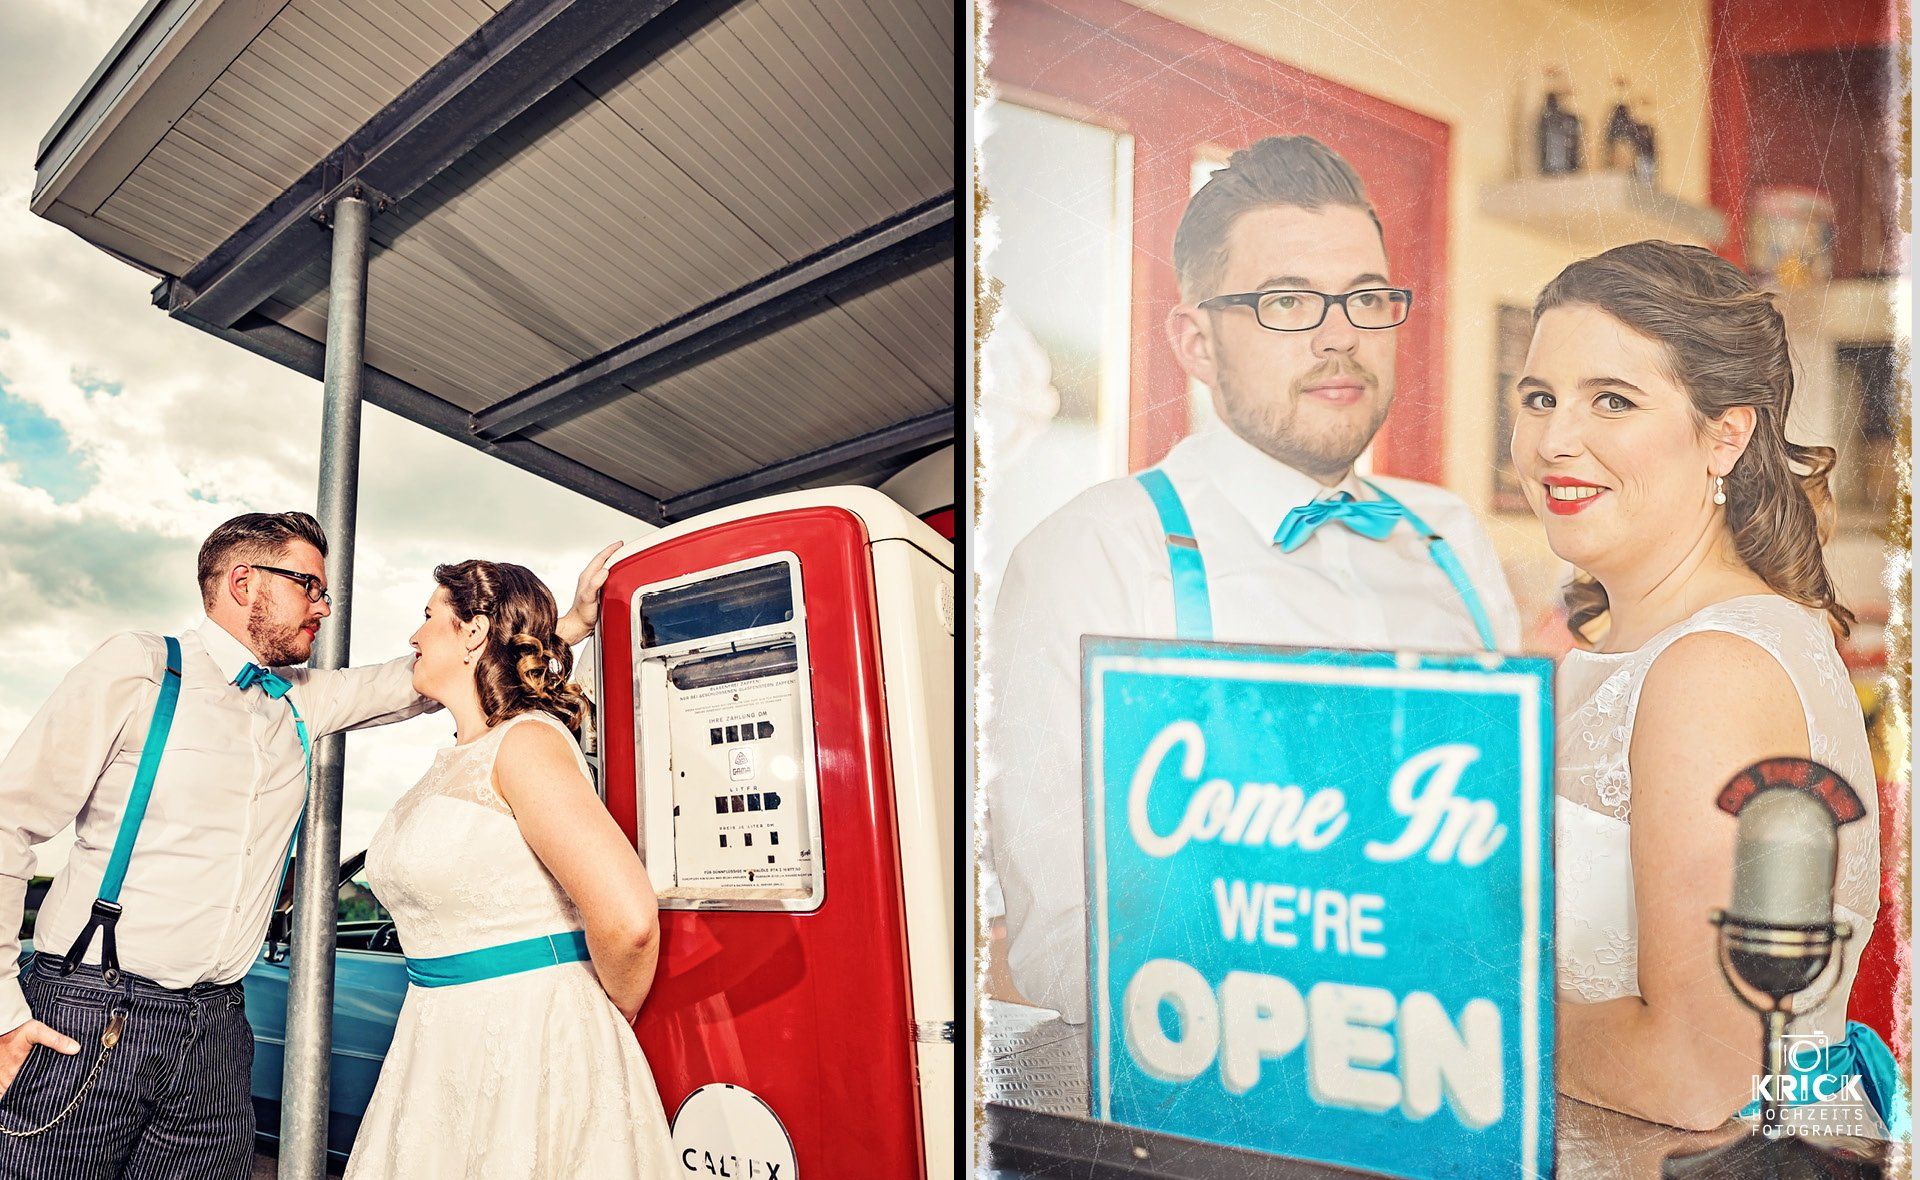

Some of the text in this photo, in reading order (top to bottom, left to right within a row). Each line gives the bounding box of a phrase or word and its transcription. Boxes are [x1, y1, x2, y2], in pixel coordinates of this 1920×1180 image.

[726, 712, 756, 722] ZAHLUNG
[1128, 720, 1507, 867] Come In
[1213, 877, 1387, 958] WE'RE
[1123, 957, 1505, 1131] OPEN
